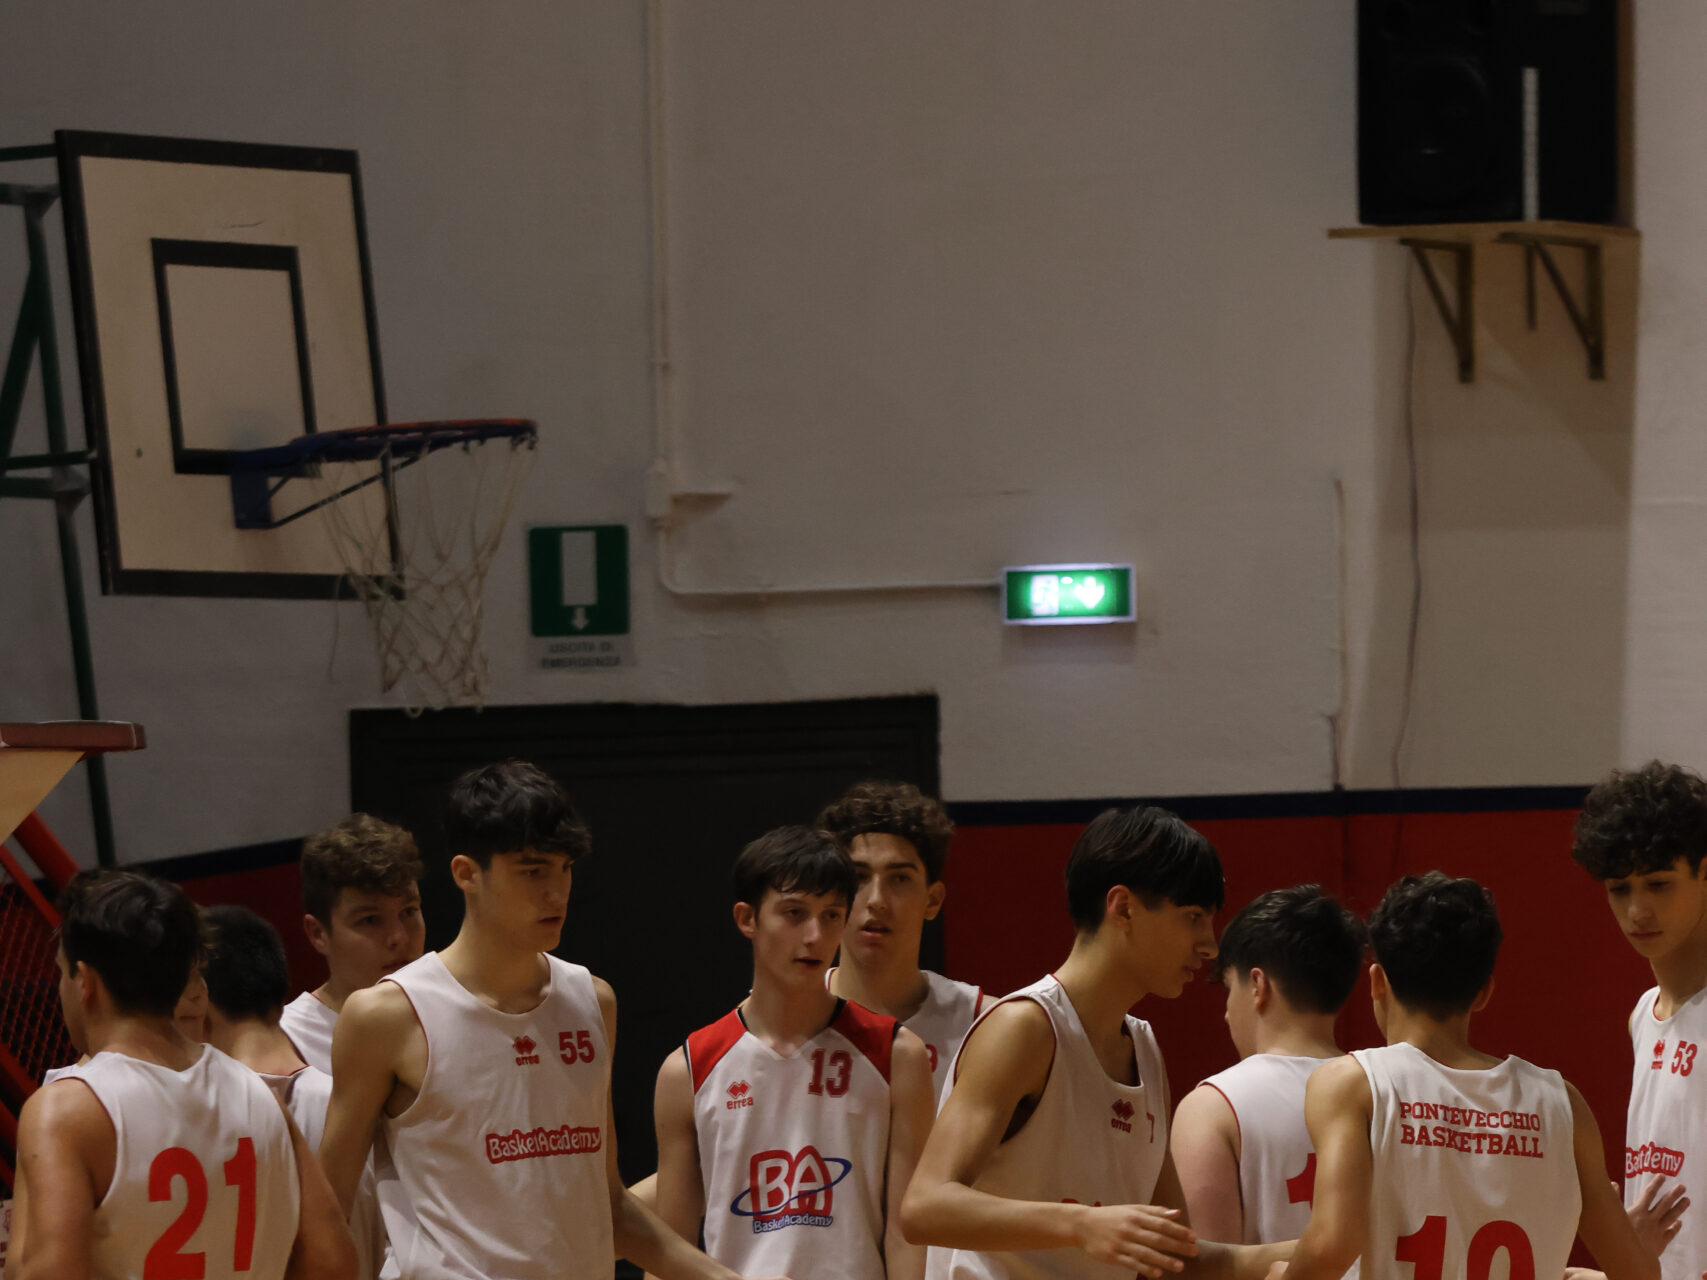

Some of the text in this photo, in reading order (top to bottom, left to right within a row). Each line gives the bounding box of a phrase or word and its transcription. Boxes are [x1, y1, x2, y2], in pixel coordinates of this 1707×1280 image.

[558, 1030, 595, 1065] 55
[1671, 1040, 1698, 1077] 53
[808, 1048, 853, 1098] 13
[726, 1096, 754, 1110] errea
[1400, 1101, 1541, 1132] PONTEVECCHIO
[1400, 1124, 1544, 1158] BASKETBALL
[752, 1147, 832, 1218] BA
[143, 1137, 257, 1280] 21
